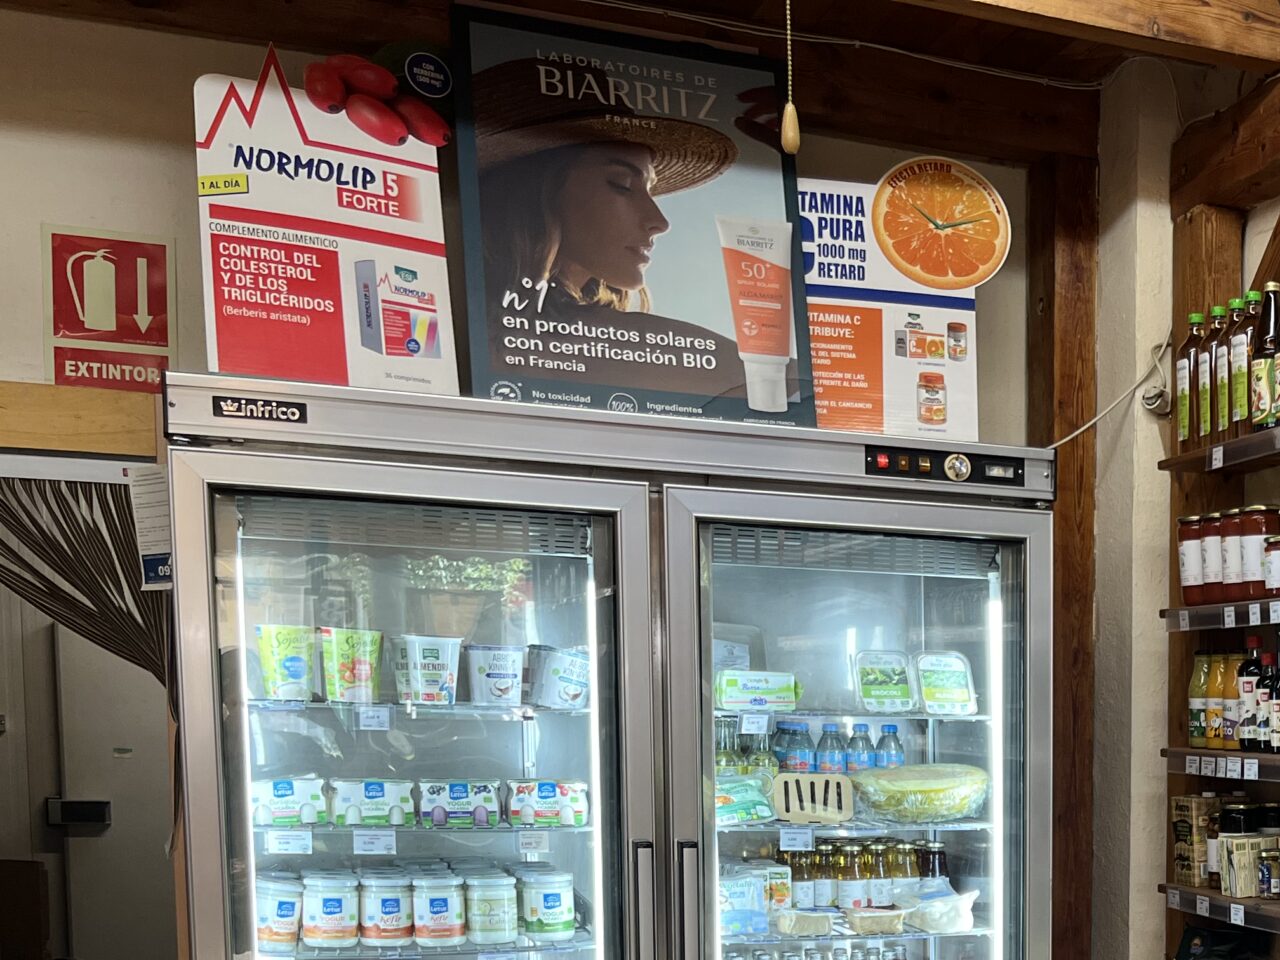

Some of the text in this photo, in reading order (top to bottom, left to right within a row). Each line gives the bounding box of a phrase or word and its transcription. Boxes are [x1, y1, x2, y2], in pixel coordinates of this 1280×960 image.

[535, 49, 718, 88] LABORATOIRES DE
[537, 65, 720, 124] BIARRITZ
[605, 113, 657, 130] FRANCE
[232, 144, 399, 197] NORMOLIP 5
[888, 162, 953, 189] EFECTO RETARD
[200, 178, 241, 190] 1 AL DÍA
[341, 191, 400, 217] FORTE
[797, 190, 867, 218] TAMINA
[208, 221, 339, 250] COMPLEMENTO ALIMENTICIO
[817, 216, 866, 243] PURA
[219, 242, 322, 268] CONTROL DEL
[736, 238, 775, 251] BIARRITZ
[816, 243, 867, 264] 1000 mg
[219, 257, 316, 282] COLESTEROL
[220, 271, 288, 291] Y DE LOS
[818, 262, 866, 282] RETARD
[221, 286, 335, 313] TRIGLICÉRIDOS
[222, 305, 311, 326] (Berberis aristata)
[808, 312, 862, 326] ITAMINA C
[502, 315, 717, 351] en productos solares
[808, 325, 855, 339] TRIBUYE:
[504, 335, 718, 371] con certificación BIO
[505, 355, 587, 373] en Francia
[64, 360, 159, 385] EXTINTOR
[531, 389, 592, 404] No toxicidad
[646, 401, 704, 415] Ingredientes
[238, 398, 301, 421] infrico
